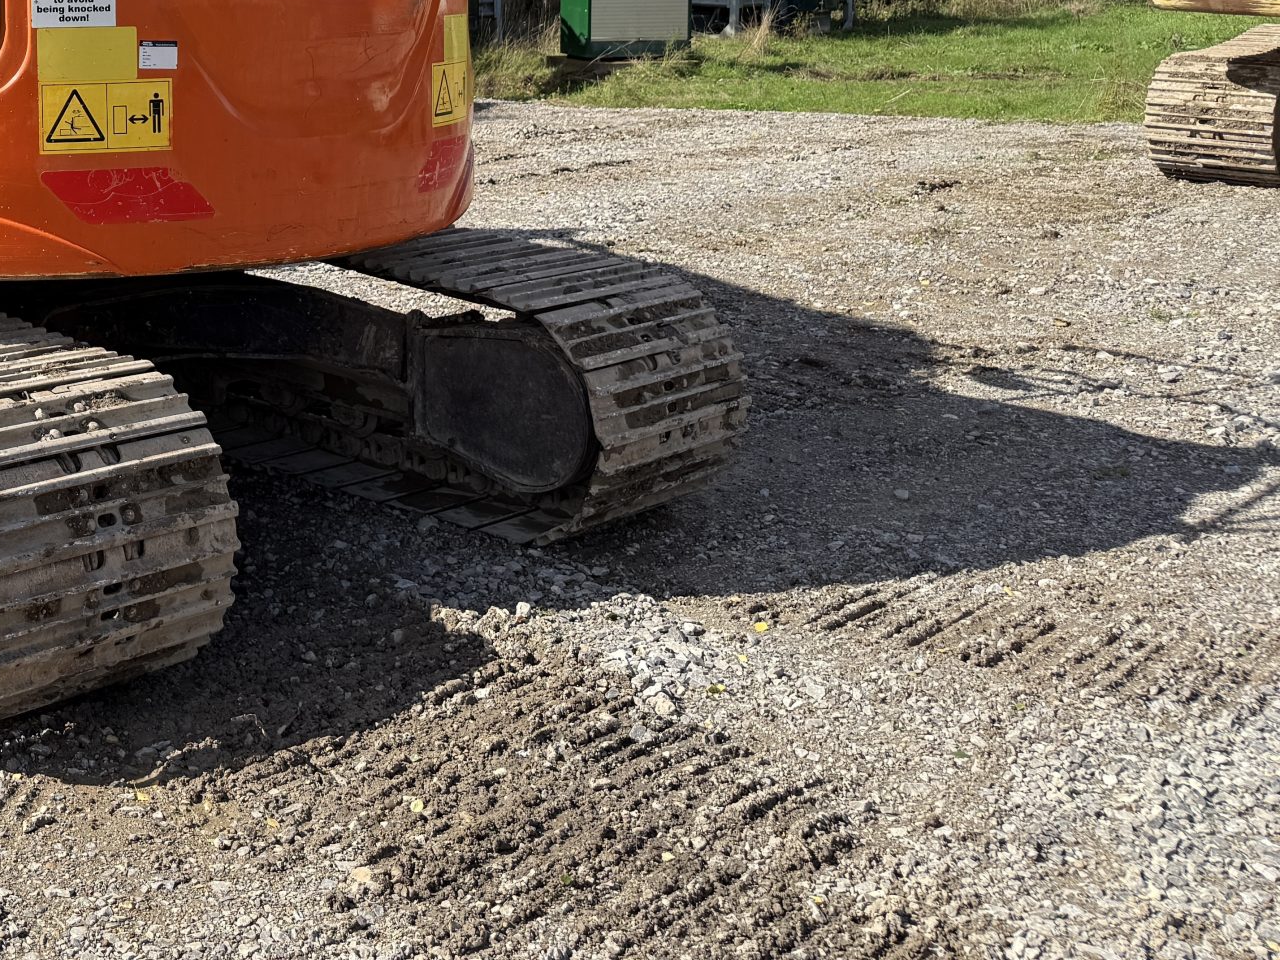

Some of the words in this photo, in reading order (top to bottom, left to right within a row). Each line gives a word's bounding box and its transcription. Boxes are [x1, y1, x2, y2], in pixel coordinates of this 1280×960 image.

[36, 5, 65, 15] being
[67, 4, 111, 13] knocked
[58, 14, 90, 23] down!
